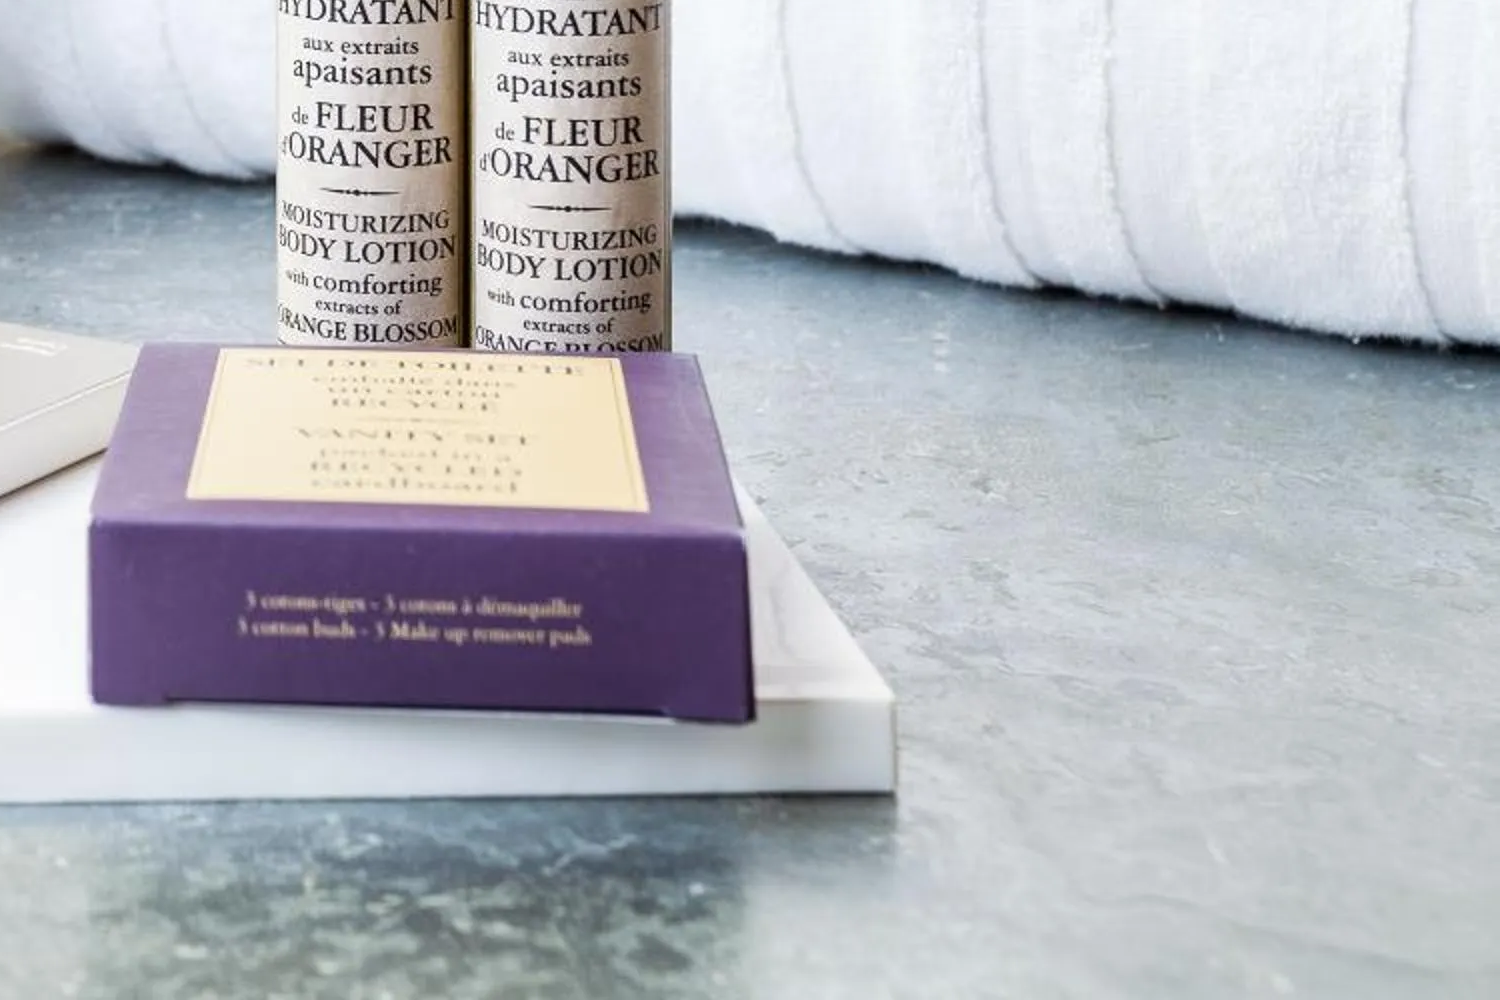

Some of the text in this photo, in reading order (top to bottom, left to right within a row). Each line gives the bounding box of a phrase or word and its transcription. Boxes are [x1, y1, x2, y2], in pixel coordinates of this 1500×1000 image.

[476, 0, 662, 37] HYDRATANT
[302, 36, 419, 55] aux extraits
[507, 48, 629, 67] aux extraits
[292, 56, 432, 88] apaisants
[497, 70, 642, 101] apaisants
[291, 101, 434, 133] de FLEUR
[495, 116, 644, 147] de FLEUR
[480, 148, 660, 183] d'ORANGER
[281, 200, 450, 233] MOISTURIZING
[279, 223, 456, 265] BODY LOTION
[482, 219, 657, 251] MOISTURIZING
[478, 244, 661, 282] BODY LOTION
[313, 274, 443, 297] comforting
[487, 288, 652, 314] with comforting
[315, 298, 404, 315] extracts of
[354, 315, 458, 343] BLOSSOM
[523, 317, 614, 334] extracts of
